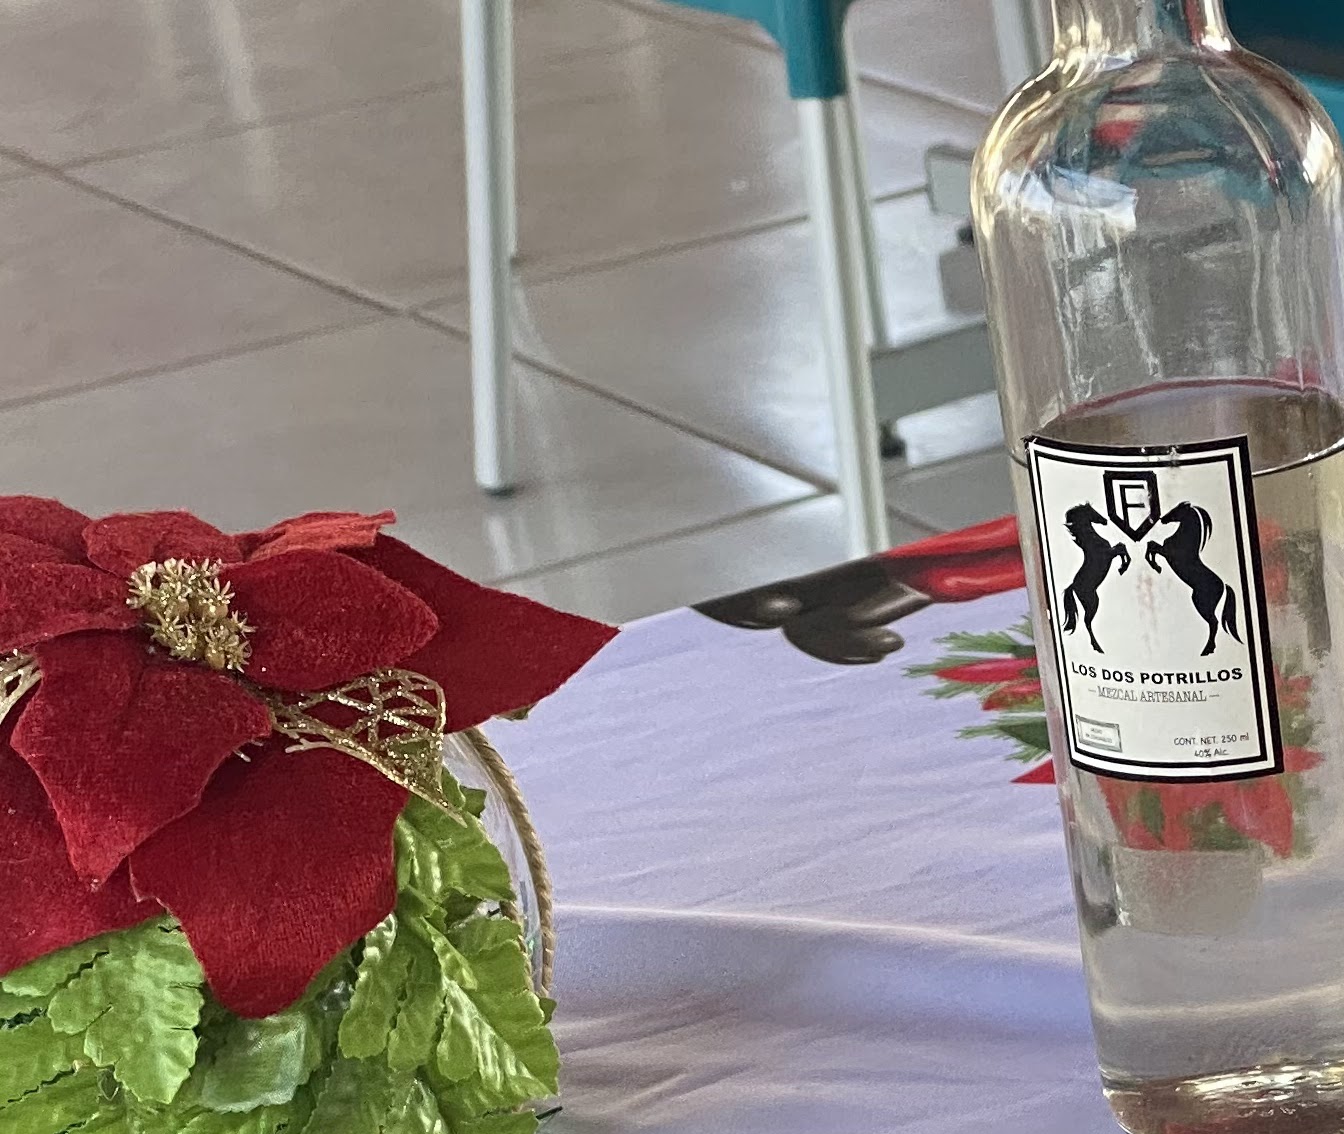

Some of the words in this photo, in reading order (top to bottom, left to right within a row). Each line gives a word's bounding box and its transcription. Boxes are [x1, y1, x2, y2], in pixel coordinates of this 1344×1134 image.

[1071, 661, 1098, 679] LOS
[1102, 669, 1135, 684] DOS
[1140, 667, 1243, 685] POTRILLOS
[1097, 686, 1138, 701] MEZCAL
[1140, 690, 1207, 703] ARTESANAL
[1221, 734, 1237, 743] 250
